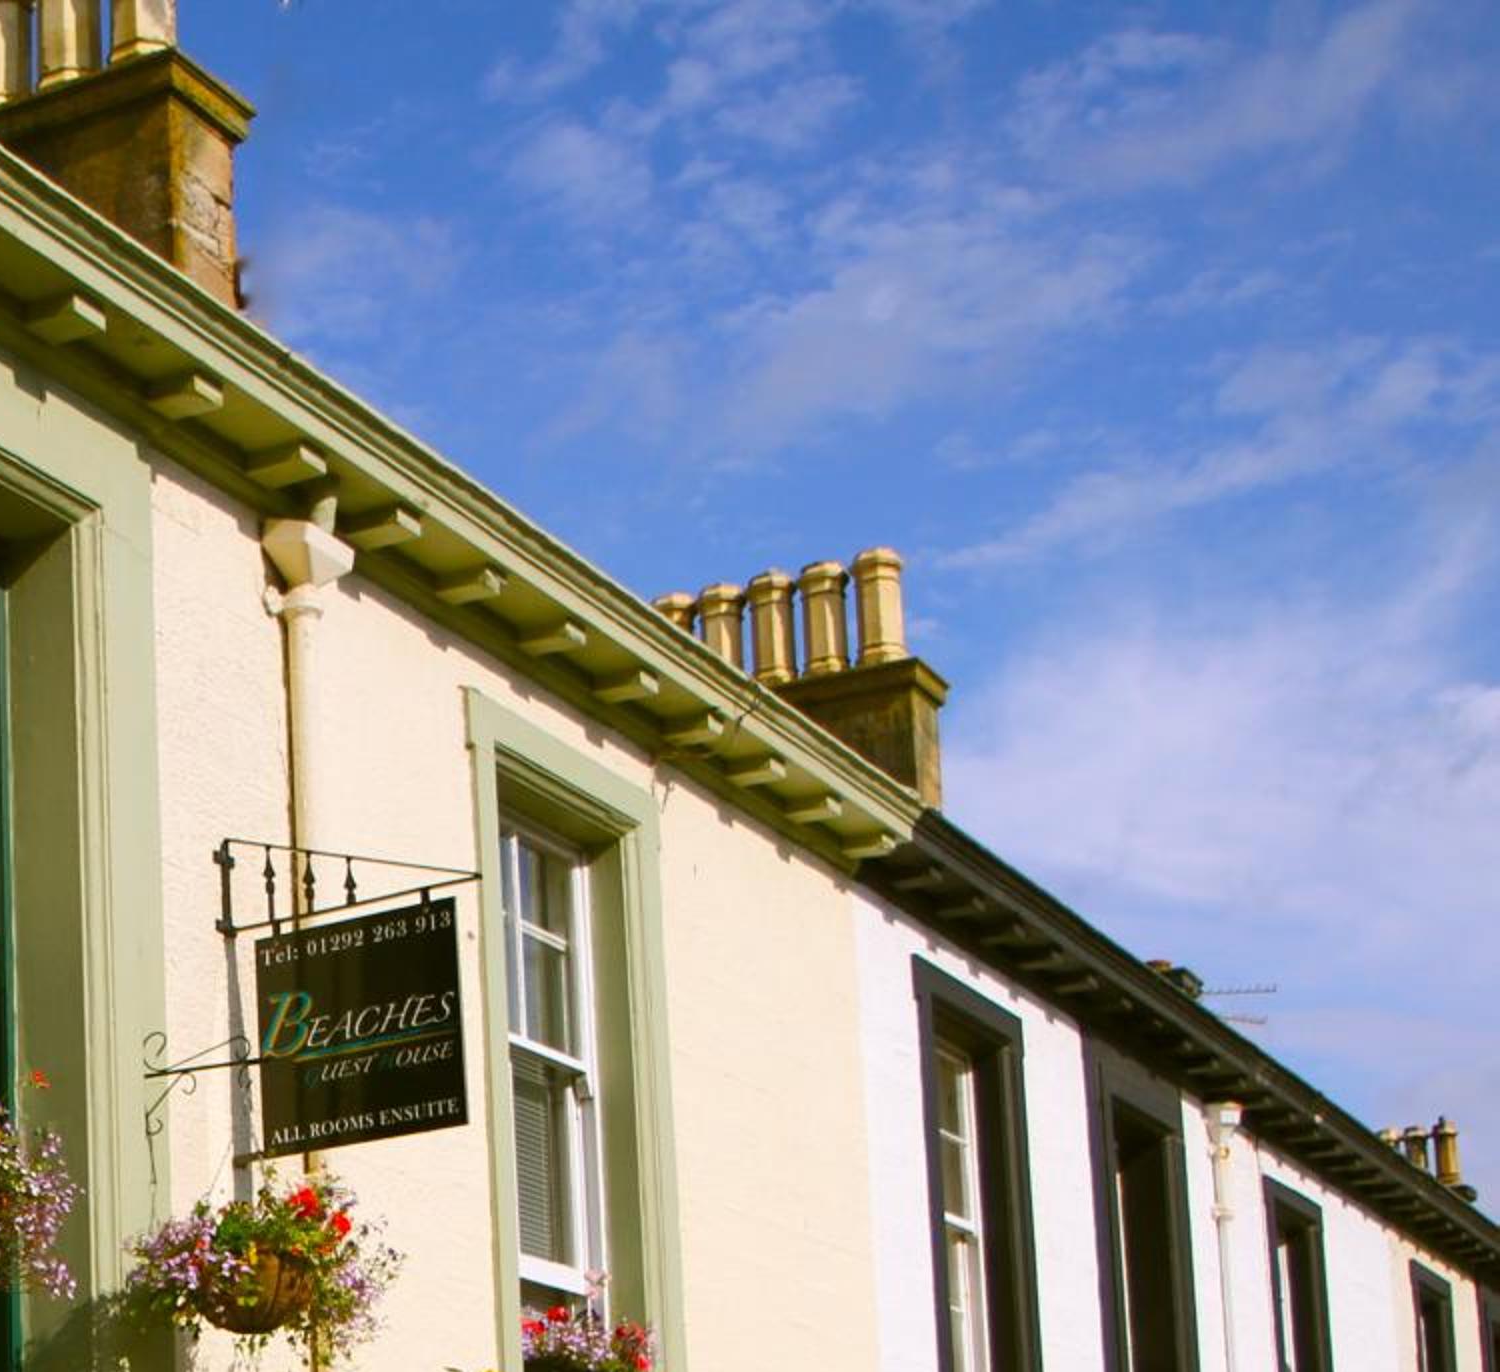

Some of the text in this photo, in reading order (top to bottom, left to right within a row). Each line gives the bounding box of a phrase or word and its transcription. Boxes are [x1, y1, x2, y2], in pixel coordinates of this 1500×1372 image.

[260, 910, 453, 967] Tel: 01292 263 913
[262, 990, 455, 1058] BEACHES
[271, 1096, 460, 1146] ALL ROOMS ENSUITE
